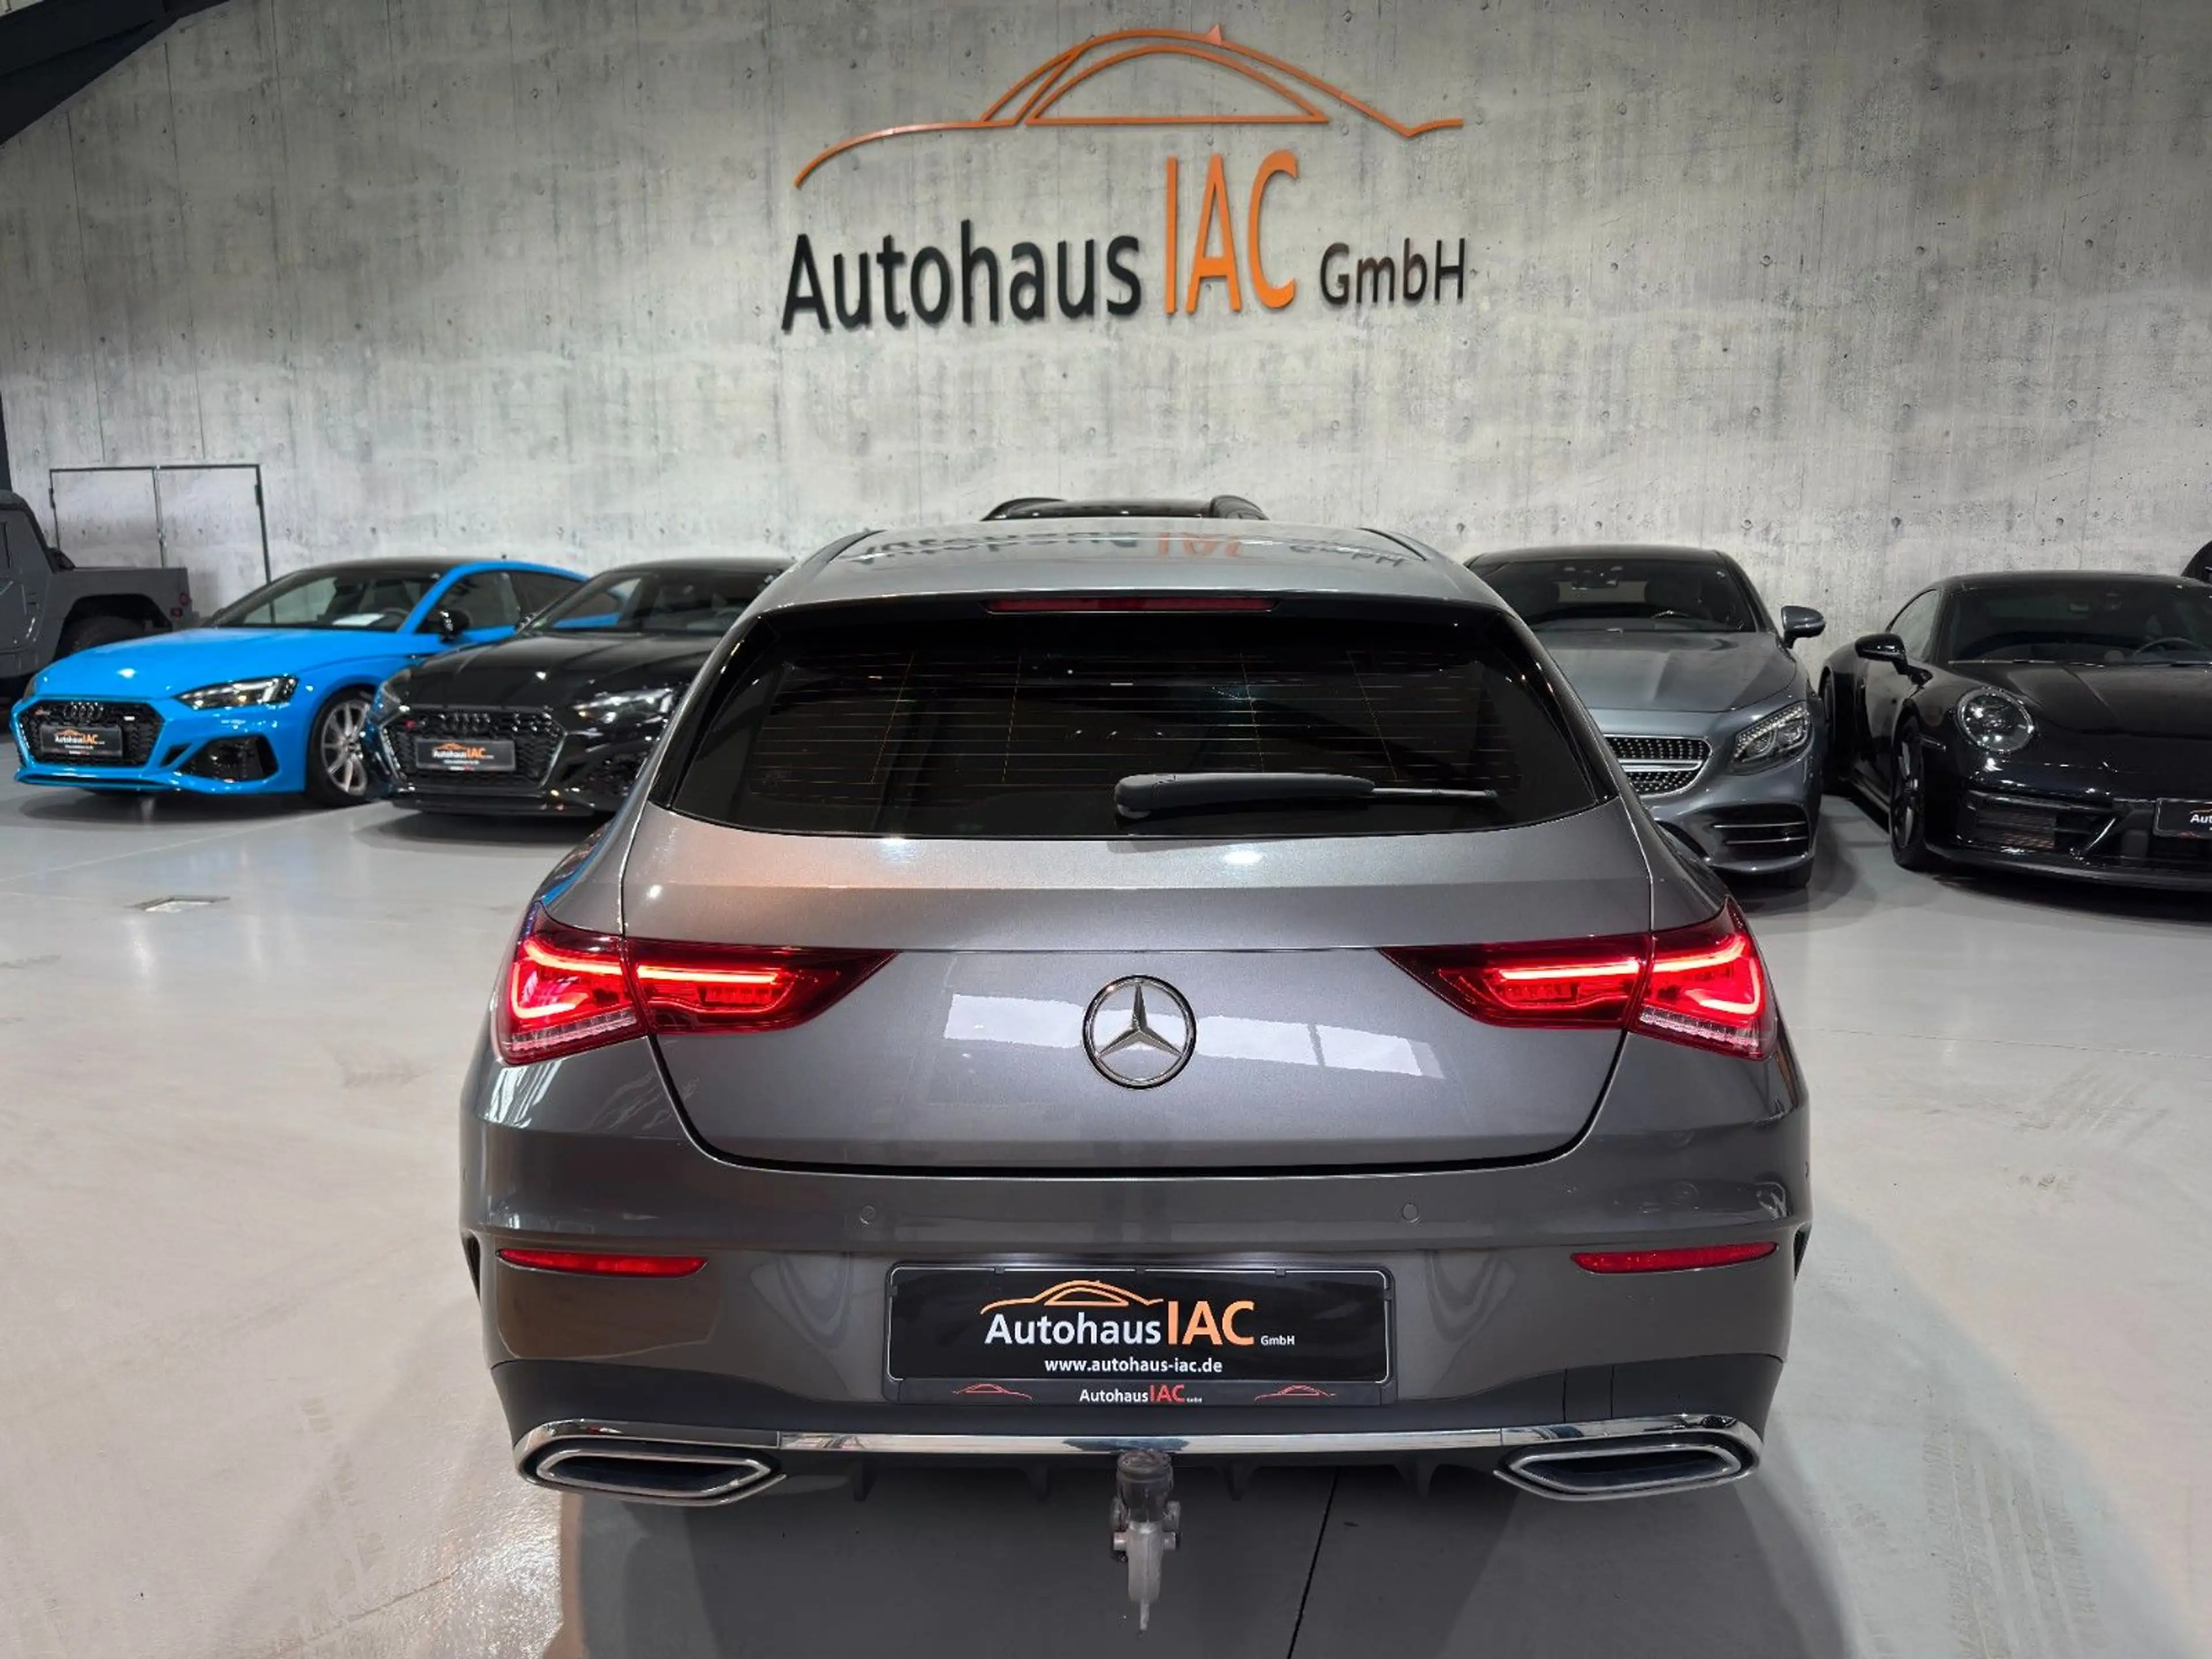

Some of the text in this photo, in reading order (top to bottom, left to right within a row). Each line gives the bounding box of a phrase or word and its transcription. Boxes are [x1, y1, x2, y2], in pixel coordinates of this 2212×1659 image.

[782, 151, 1466, 331] Autohaus IAC GmbH
[984, 1300, 1296, 1346] Autohaus IAC GmbH
[1044, 1356, 1224, 1373] www.autohaus-iac.de
[1079, 1388, 1149, 1403] Autohaus
[1149, 1384, 1185, 1403] IAC
